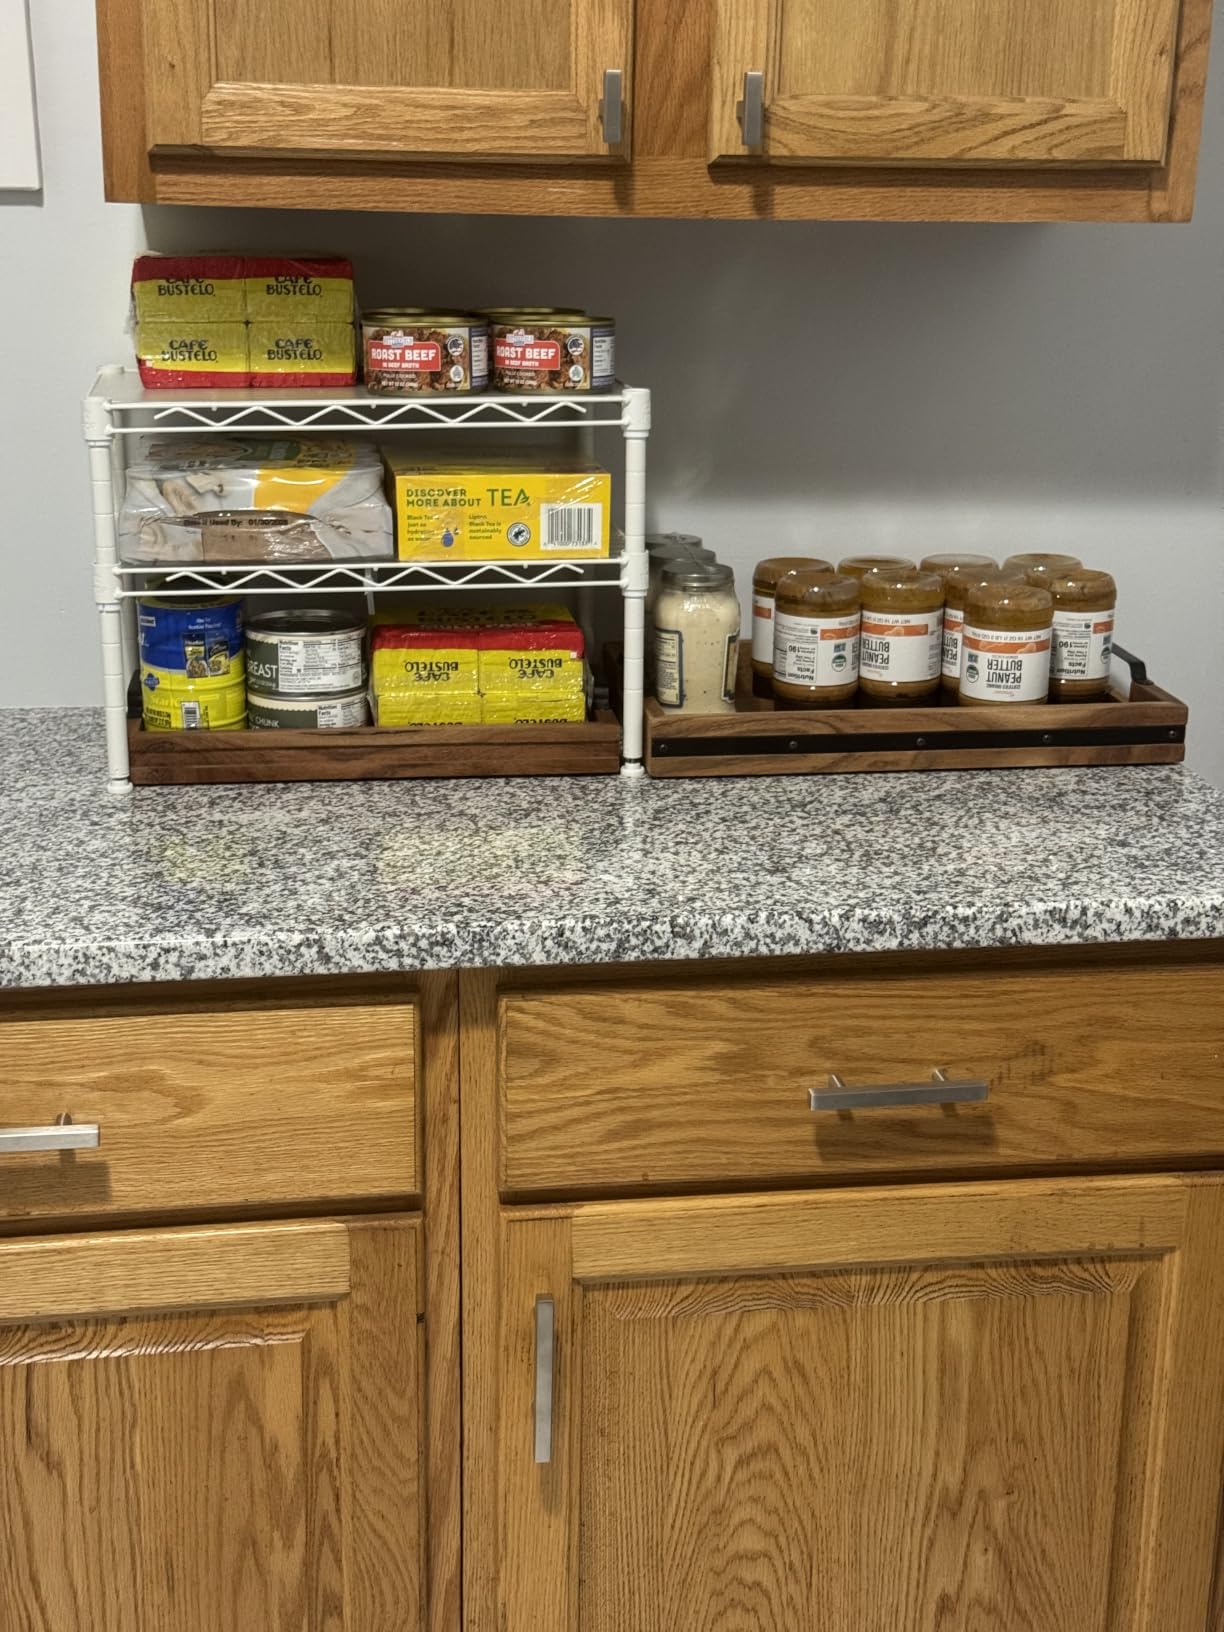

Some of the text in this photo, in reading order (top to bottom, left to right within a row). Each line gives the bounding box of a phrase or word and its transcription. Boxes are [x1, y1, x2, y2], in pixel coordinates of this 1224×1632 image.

[158, 284, 214, 296] BUSTELO
[266, 284, 322, 296] BUSTELO
[169, 339, 208, 350] CAFE
[275, 338, 313, 349] CAFE
[161, 350, 217, 361] BUSTELO
[267, 349, 322, 360] BUSTELO
[371, 348, 437, 361] ROAST BEEF
[526, 348, 557, 360] BEEF
[407, 488, 531, 506] DISCOVER TEA
[407, 498, 482, 508] MORE ABOUT
[788, 645, 800, 653] 190
[862, 639, 890, 652] BUTTER
[861, 650, 890, 665] PEANUT
[405, 661, 459, 672] BUSTELO
[509, 658, 562, 669] BUSTELO
[987, 659, 1023, 671] BUTTER
[414, 672, 450, 681] CAFE
[518, 669, 554, 679] CAFE
[787, 673, 815, 681] Nutrition
[986, 671, 1022, 684] PEANUT
[255, 716, 280, 728] CHUNK
